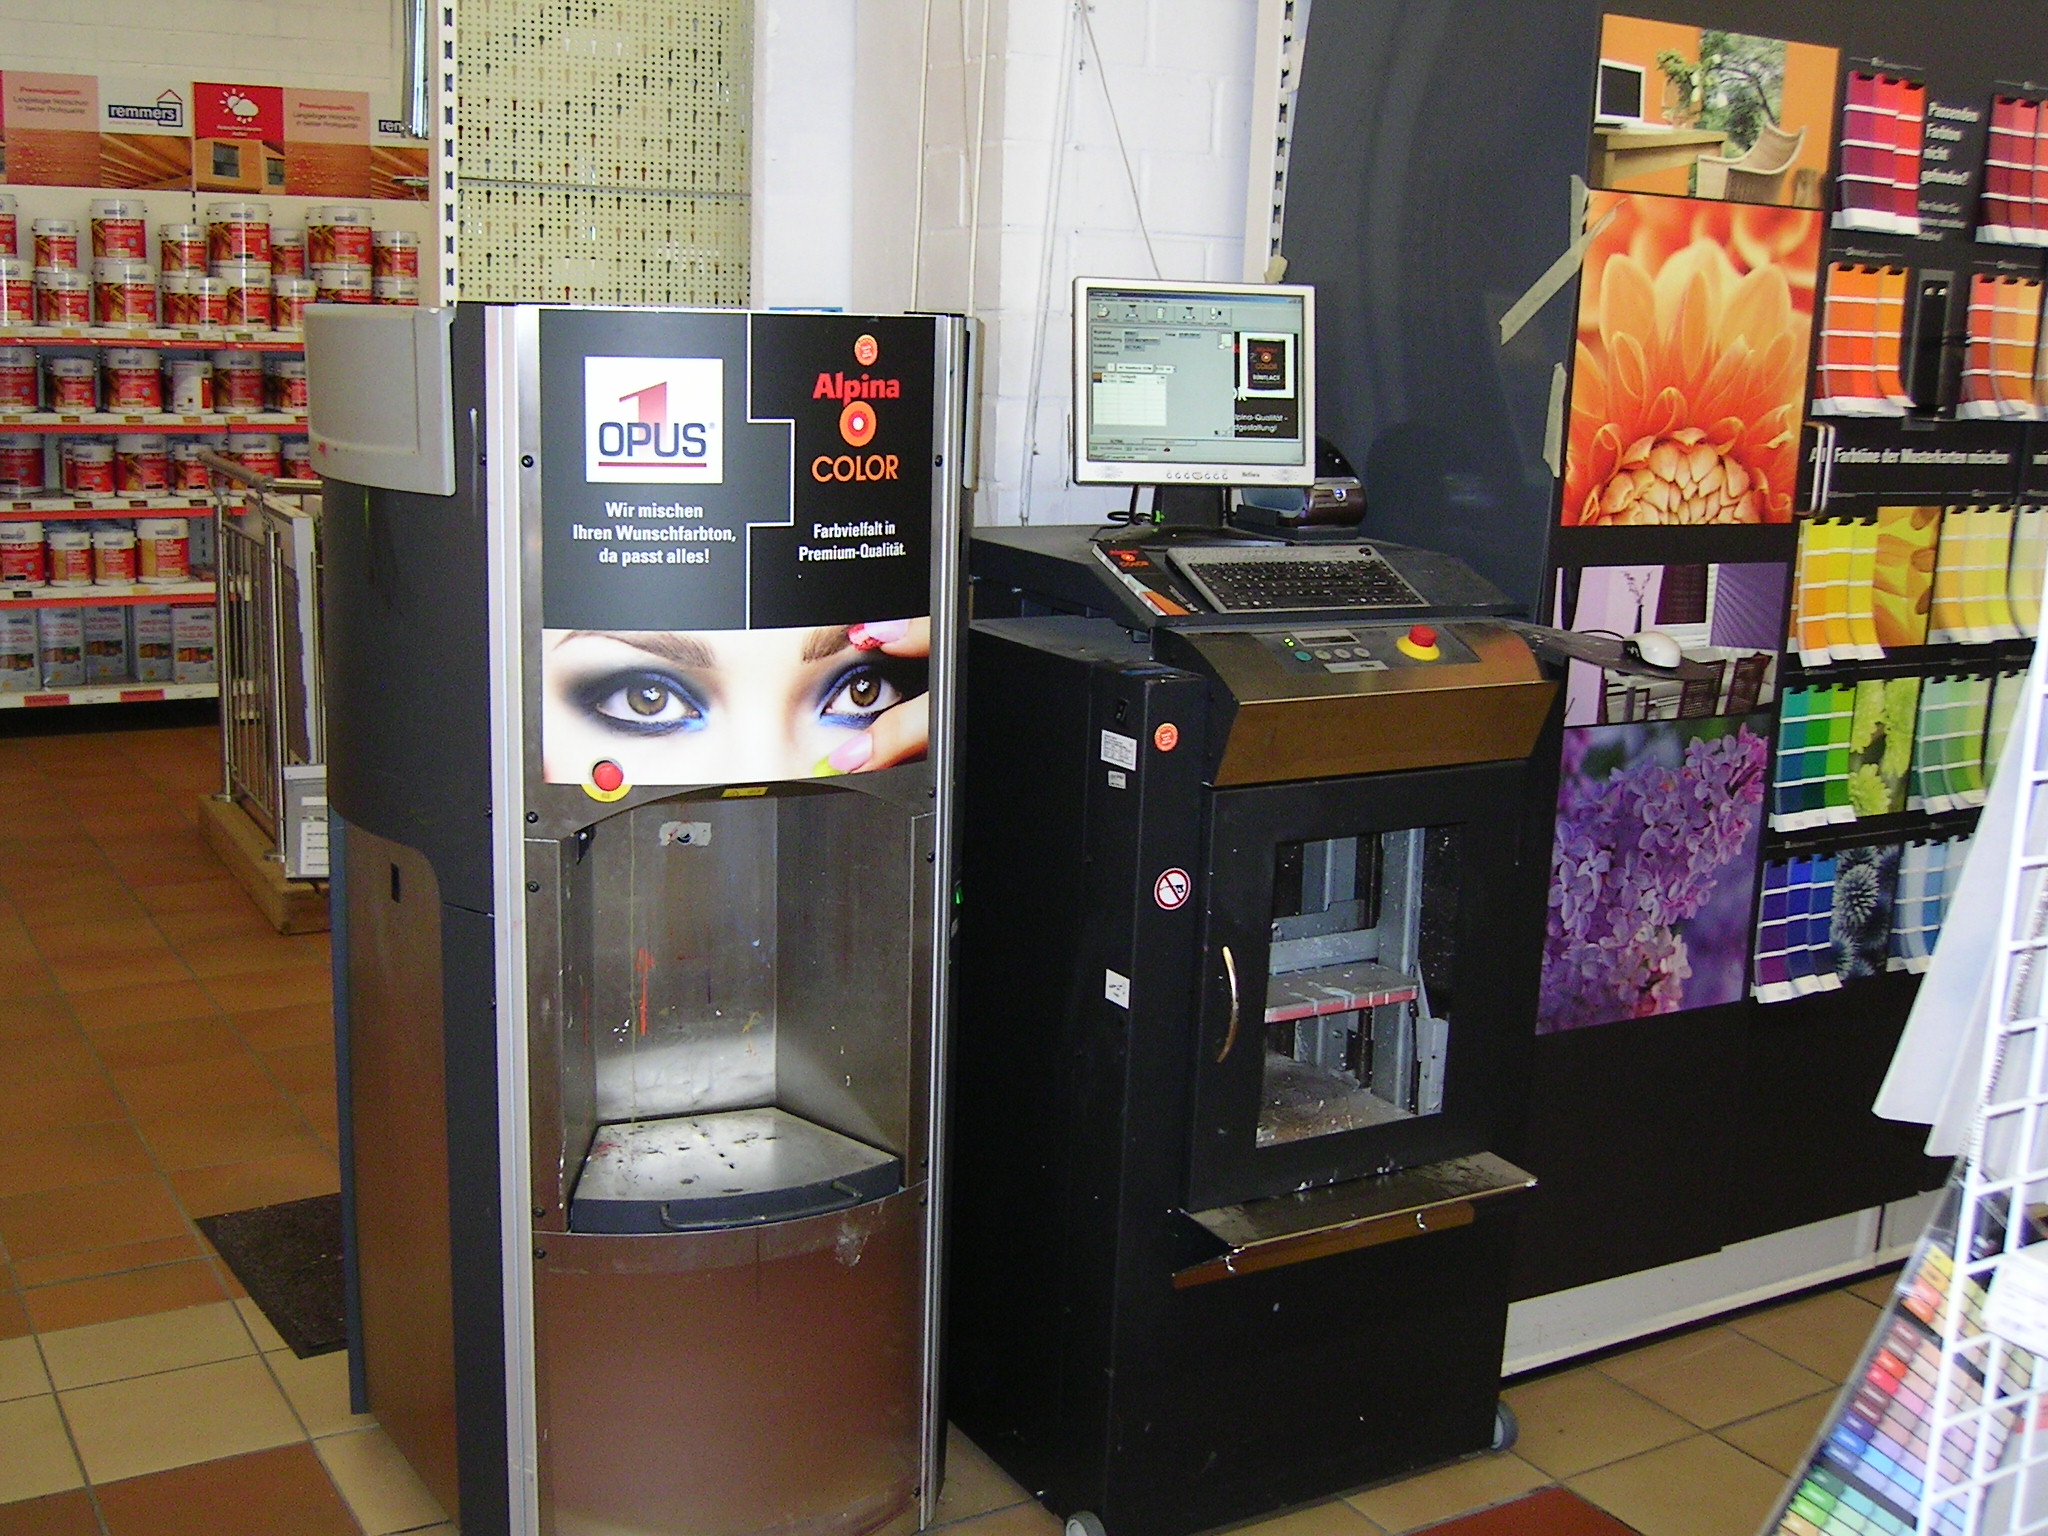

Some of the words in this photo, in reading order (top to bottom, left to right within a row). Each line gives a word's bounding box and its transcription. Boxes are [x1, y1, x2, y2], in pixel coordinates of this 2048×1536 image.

[110, 105, 176, 120] remmers
[813, 371, 900, 407] Alpina
[812, 454, 899, 483] COLOR
[605, 501, 635, 518] Wir
[638, 502, 703, 518] mischen
[573, 524, 613, 540] Ihren
[615, 524, 736, 543] Wunschfarbton,
[813, 521, 883, 539] Farbvielfalt
[884, 520, 896, 535] in
[599, 547, 618, 563] da
[621, 549, 663, 567] passt
[666, 547, 710, 564] alles!
[798, 541, 906, 562] Premium-Qualität.
